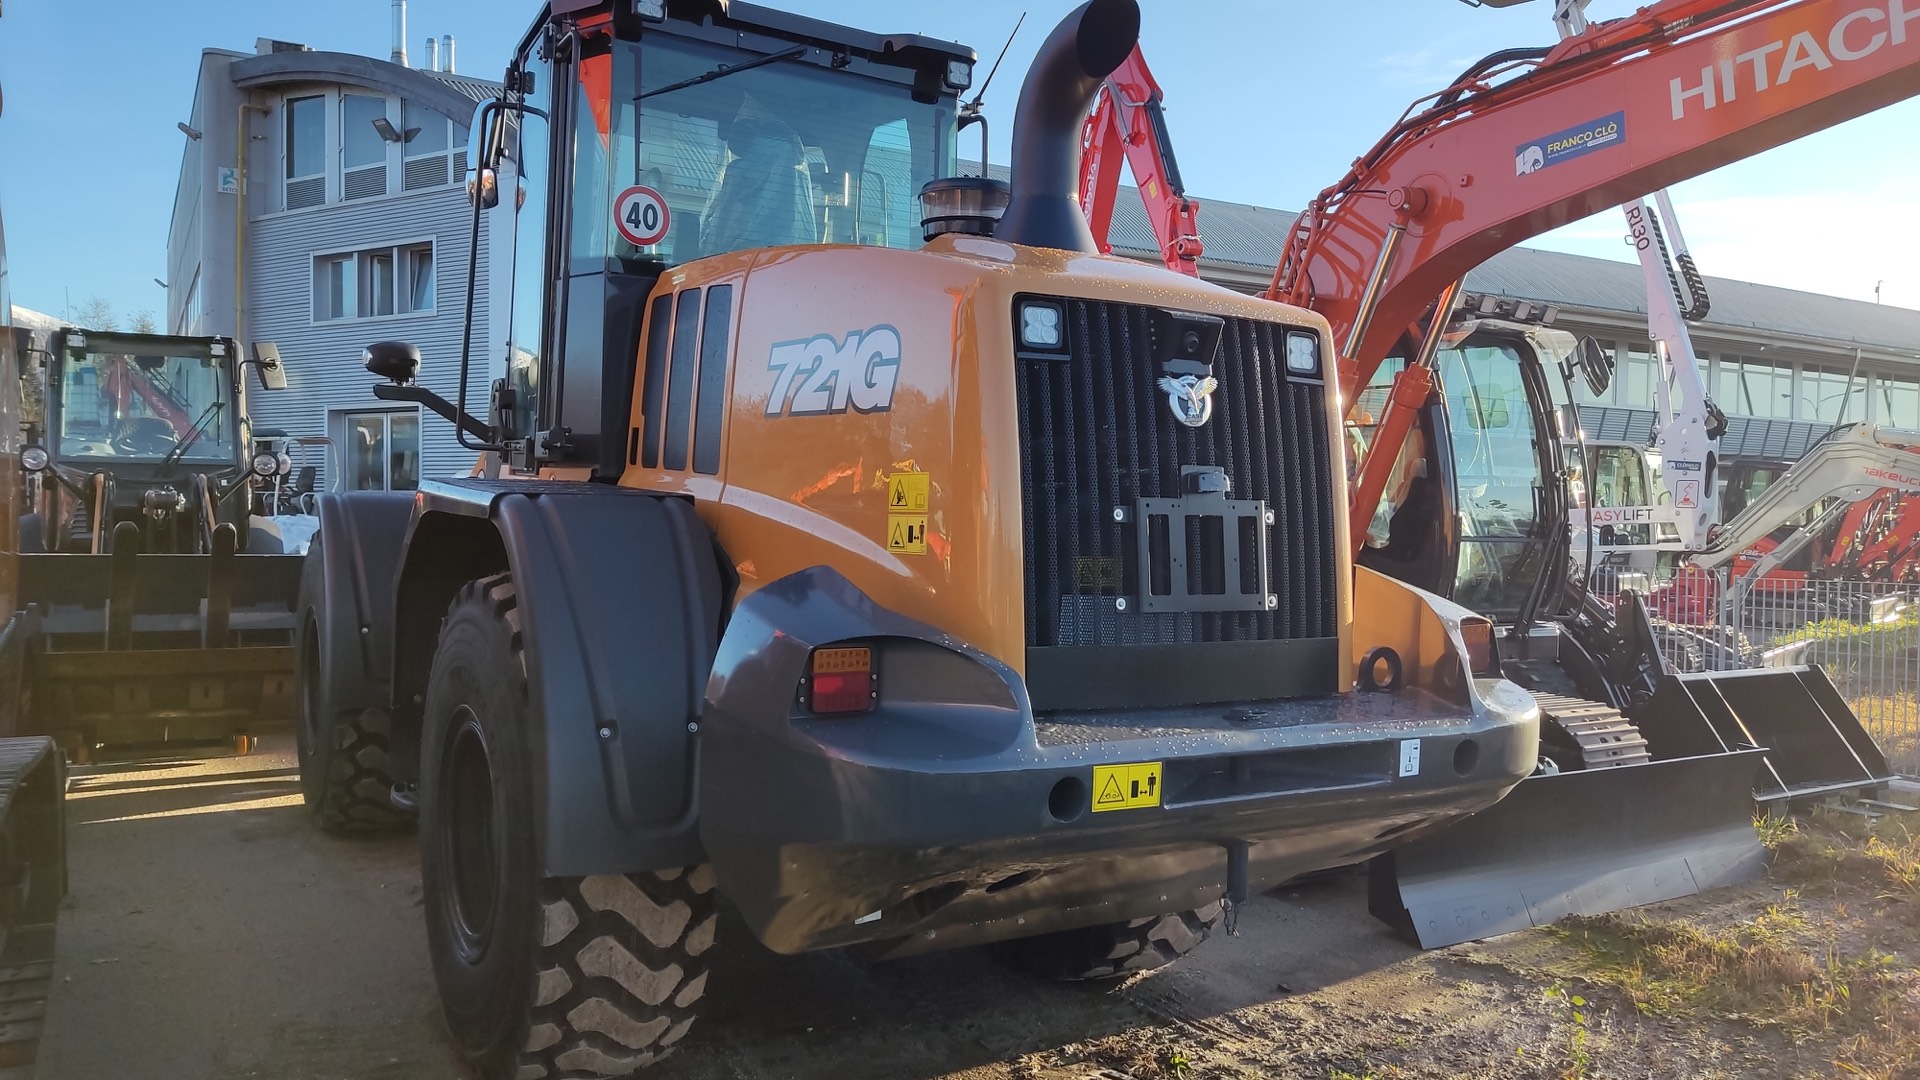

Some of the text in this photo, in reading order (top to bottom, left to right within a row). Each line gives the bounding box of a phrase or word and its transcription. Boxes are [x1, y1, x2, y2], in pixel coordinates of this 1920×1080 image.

[1547, 131, 1593, 154] FRANCO
[1594, 121, 1618, 138] CLÒ
[625, 201, 659, 231] 40
[1626, 205, 1650, 251] R130
[764, 323, 902, 420] 721G
[1863, 466, 1920, 487] Takeuc
[1585, 509, 1653, 521] ASYLIFT
